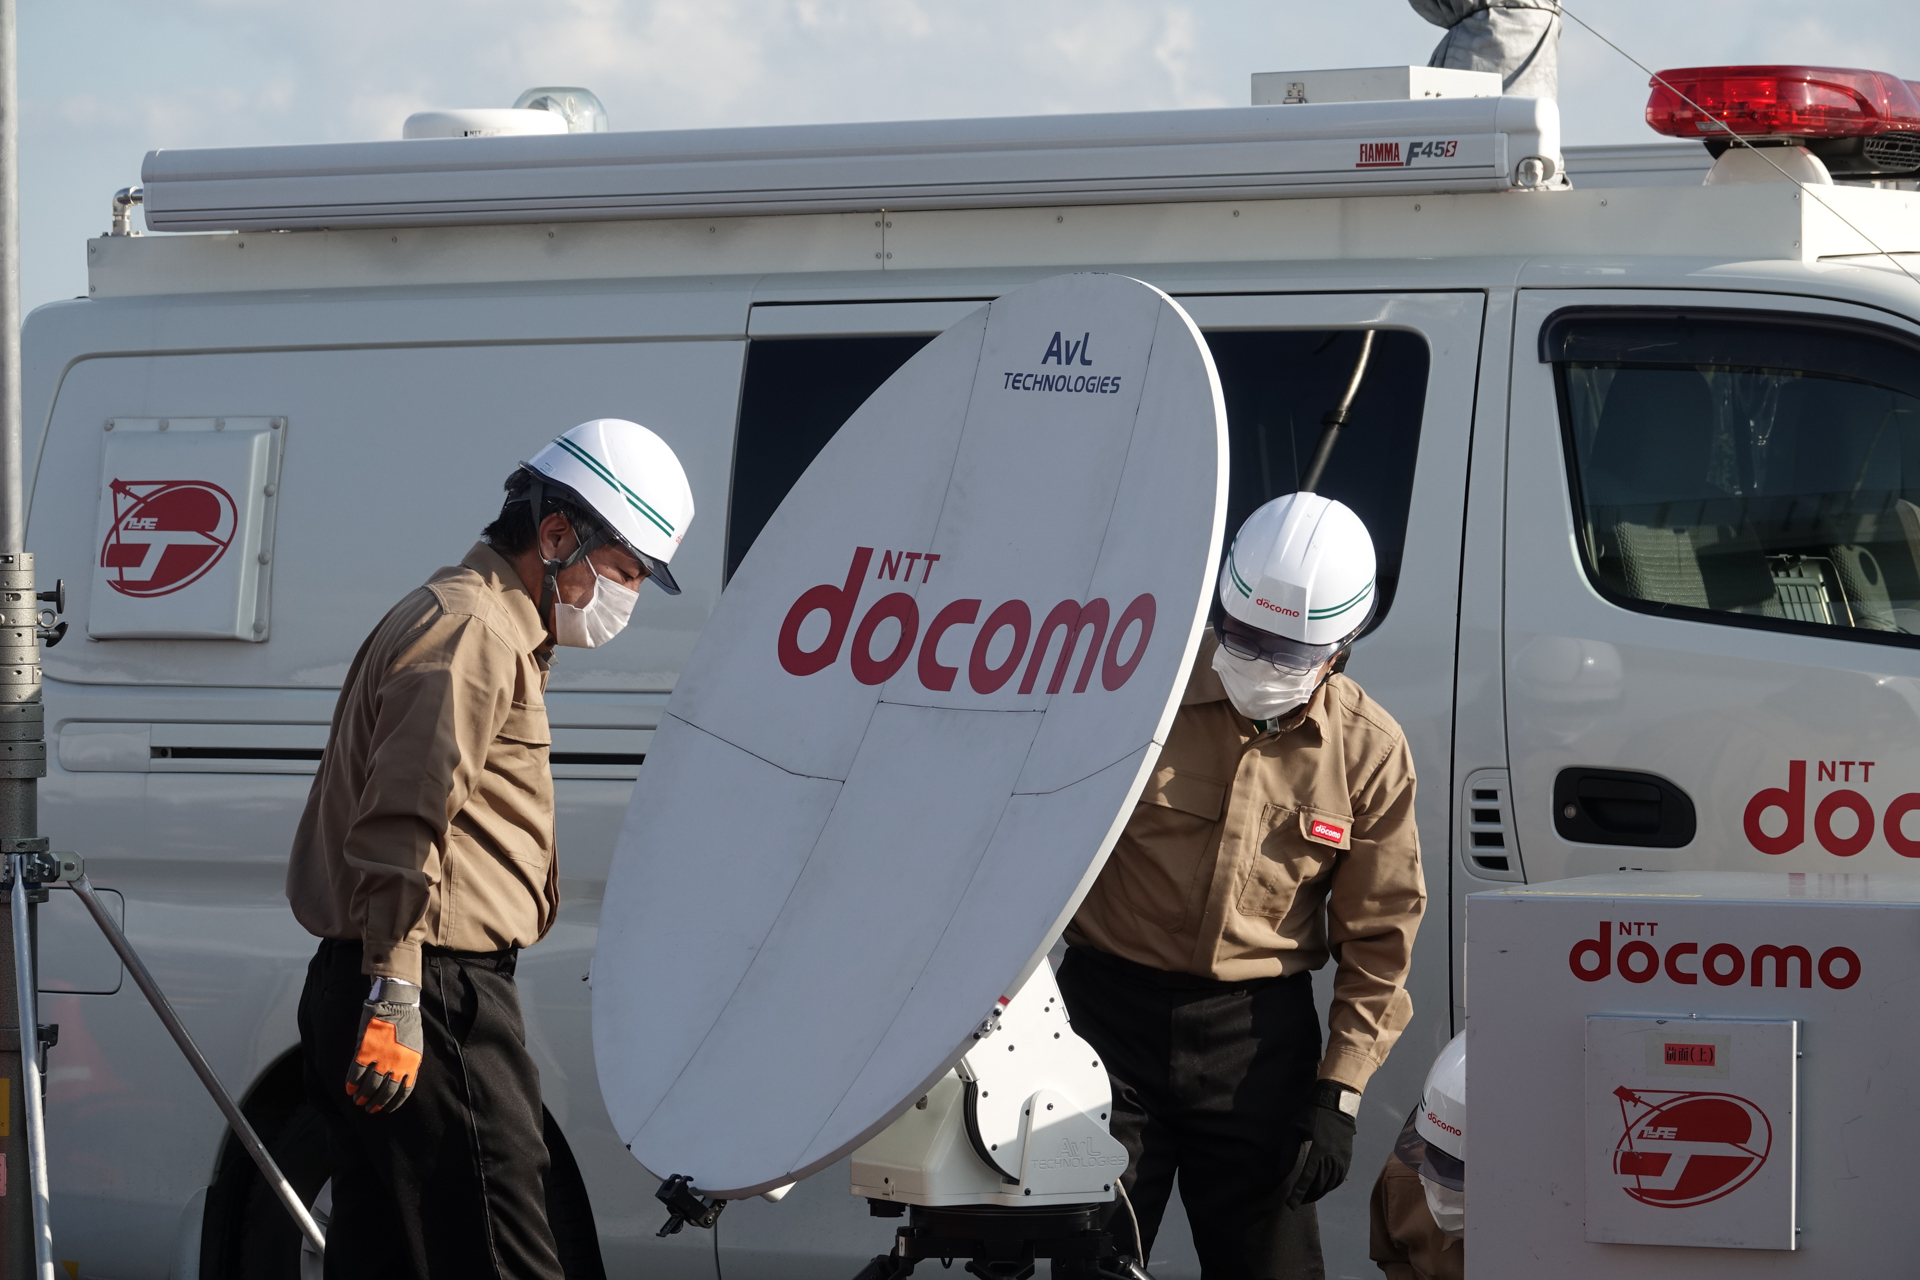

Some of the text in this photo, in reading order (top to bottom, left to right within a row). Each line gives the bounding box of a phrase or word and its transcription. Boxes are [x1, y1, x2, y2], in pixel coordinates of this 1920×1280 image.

[1360, 143, 1400, 162] FIAMMA
[1004, 372, 1121, 394] TECHNOLOGIES
[878, 550, 940, 584] NTT
[1256, 598, 1300, 618] docomo
[778, 546, 1156, 694] docomo
[1818, 760, 1875, 783] NTT
[1743, 759, 1920, 858] doc
[1315, 825, 1341, 839] docomo
[1619, 922, 1658, 936] NTT
[1569, 921, 1861, 989] docomo
[1427, 1112, 1462, 1136] docomo
[1031, 1156, 1127, 1170] TECHNOLOGIES
